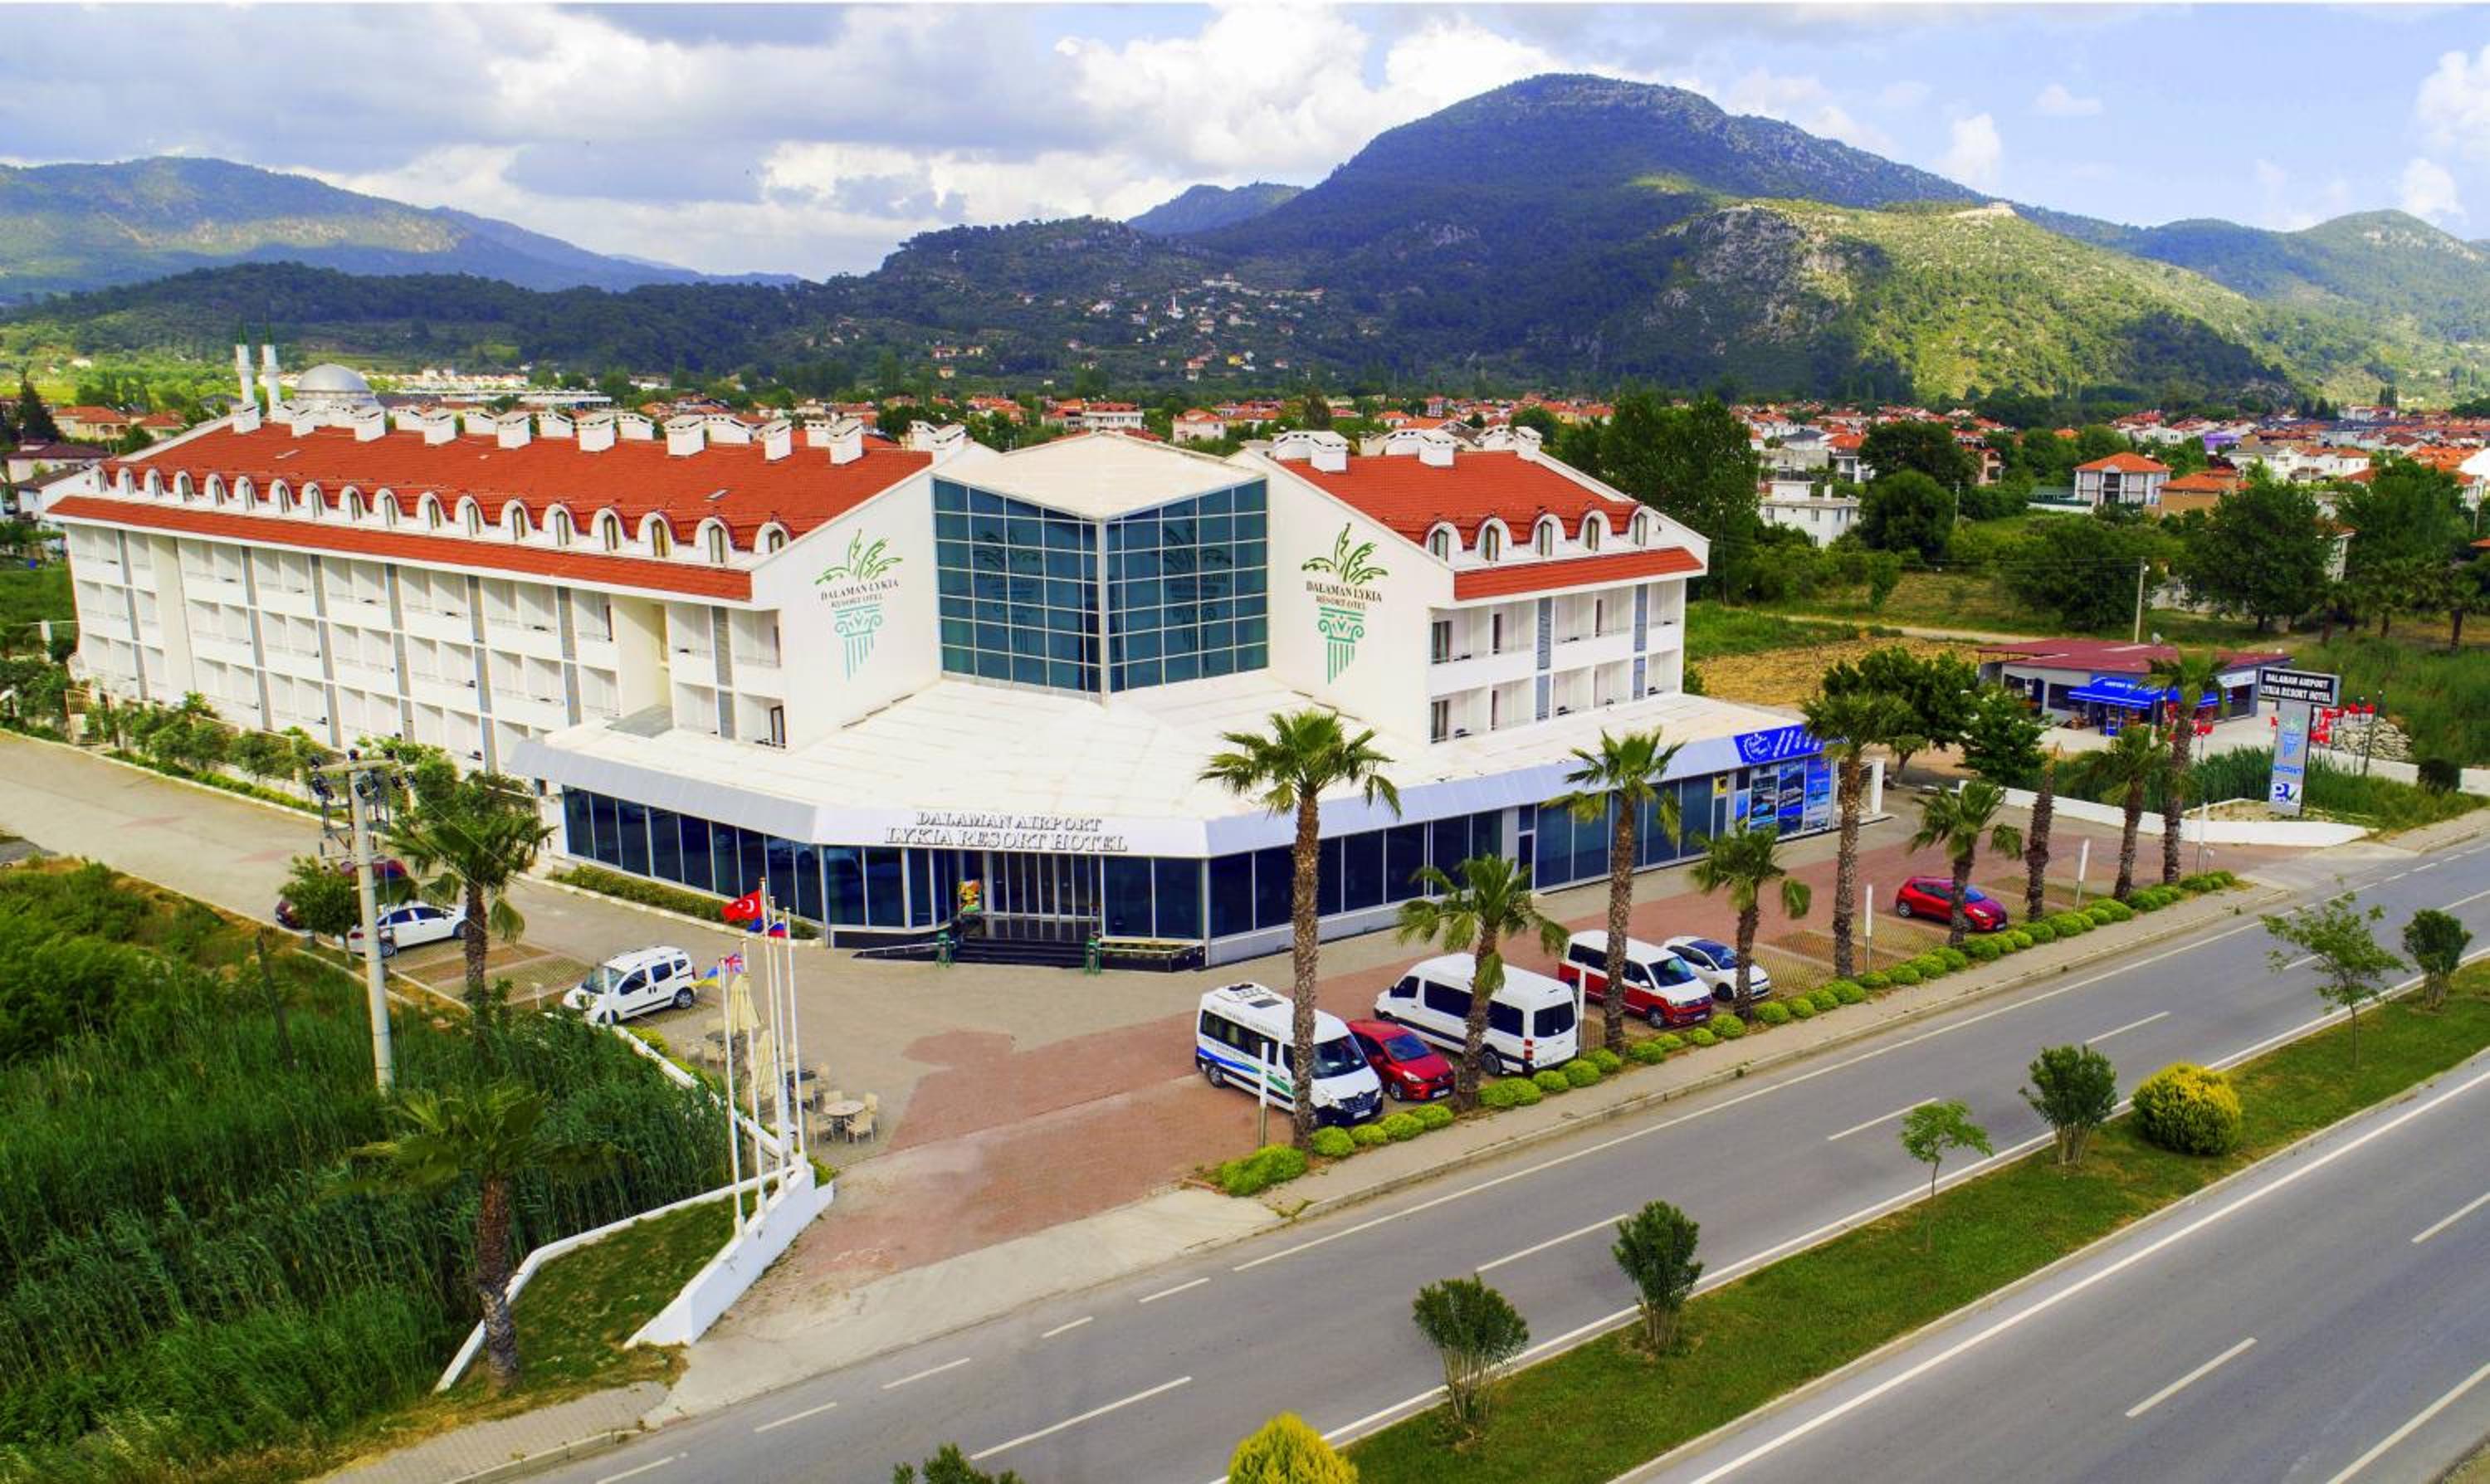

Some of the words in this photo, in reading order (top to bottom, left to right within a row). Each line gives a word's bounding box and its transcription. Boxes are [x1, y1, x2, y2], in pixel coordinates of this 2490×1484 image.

[821, 583, 867, 601] DALAMAN
[869, 578, 899, 591] LYKIA
[1306, 581, 1351, 597] DALAMAN
[1354, 588, 1382, 603] LYKIA
[2265, 673, 2298, 685] DALAMAN
[2298, 676, 2329, 689] AIRPORT
[2281, 687, 2307, 699] RESORT
[2308, 691, 2331, 702] HOTEL
[916, 811, 1013, 829] DALAMAN
[1015, 815, 1102, 831] AIRPORT
[885, 827, 954, 846] LYKIA
[956, 830, 1047, 850] RESORT
[1050, 834, 1128, 852] HOTEL
